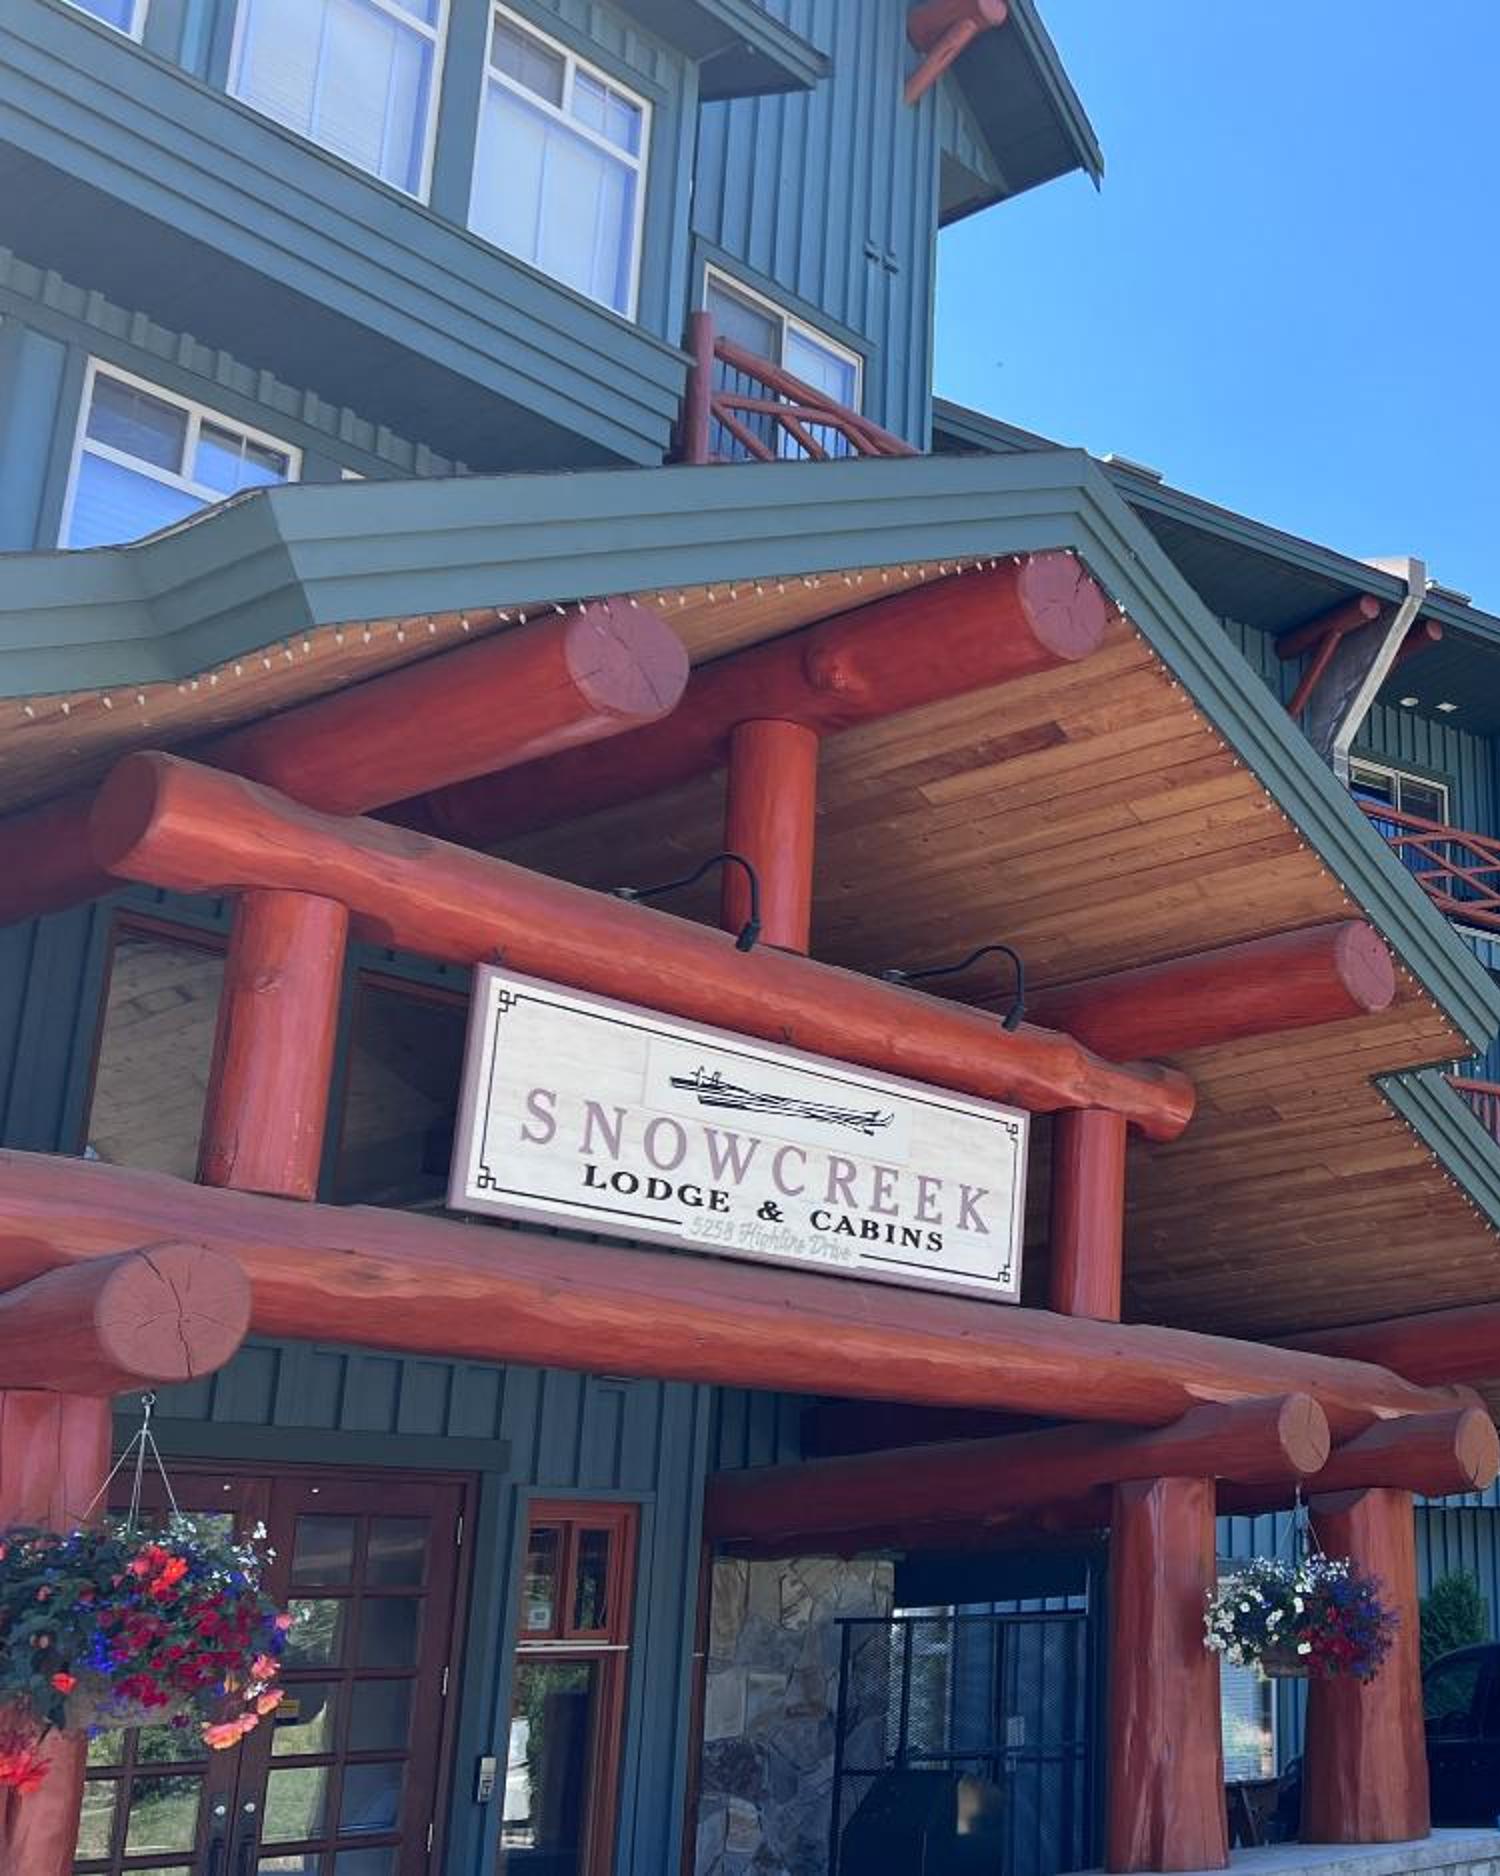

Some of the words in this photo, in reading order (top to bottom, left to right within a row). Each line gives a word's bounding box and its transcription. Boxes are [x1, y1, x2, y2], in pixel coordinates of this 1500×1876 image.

[521, 1088, 992, 1236] SNOWCREEK
[583, 1164, 730, 1214] LODGE
[757, 1201, 785, 1223] &
[810, 1210, 944, 1252] CABINS
[808, 1233, 852, 1261] Drive
